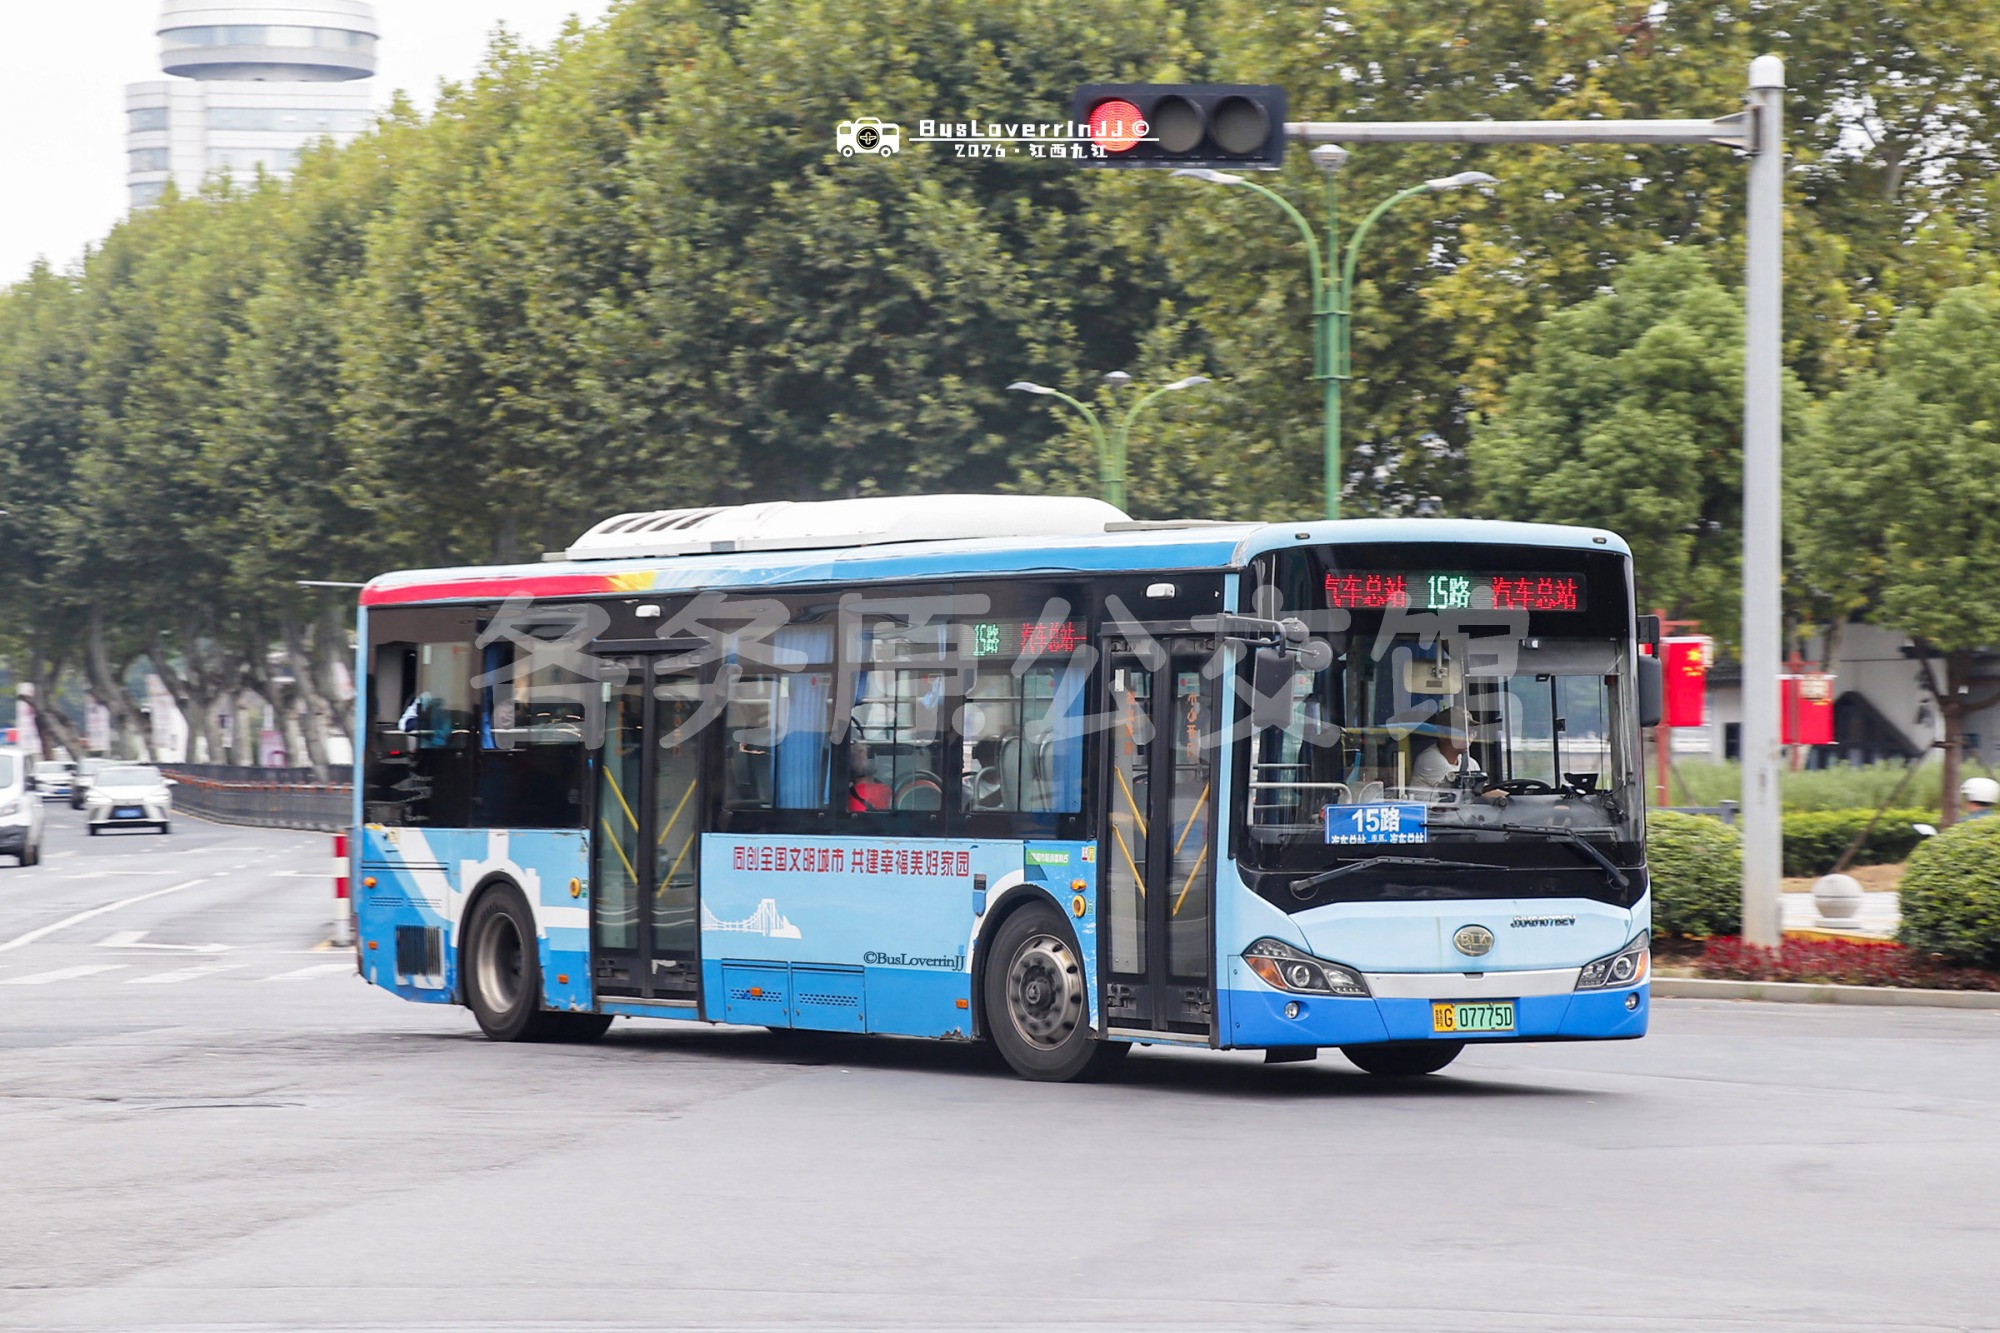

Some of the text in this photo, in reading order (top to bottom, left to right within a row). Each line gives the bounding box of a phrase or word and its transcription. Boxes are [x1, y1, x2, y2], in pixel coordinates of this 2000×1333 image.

[1427, 575, 1471, 609] 15路
[1491, 576, 1578, 611] 汽车总站
[1351, 805, 1401, 833] 15路
[733, 846, 970, 877] 同创全国文明城市 共建幸福美好家园
